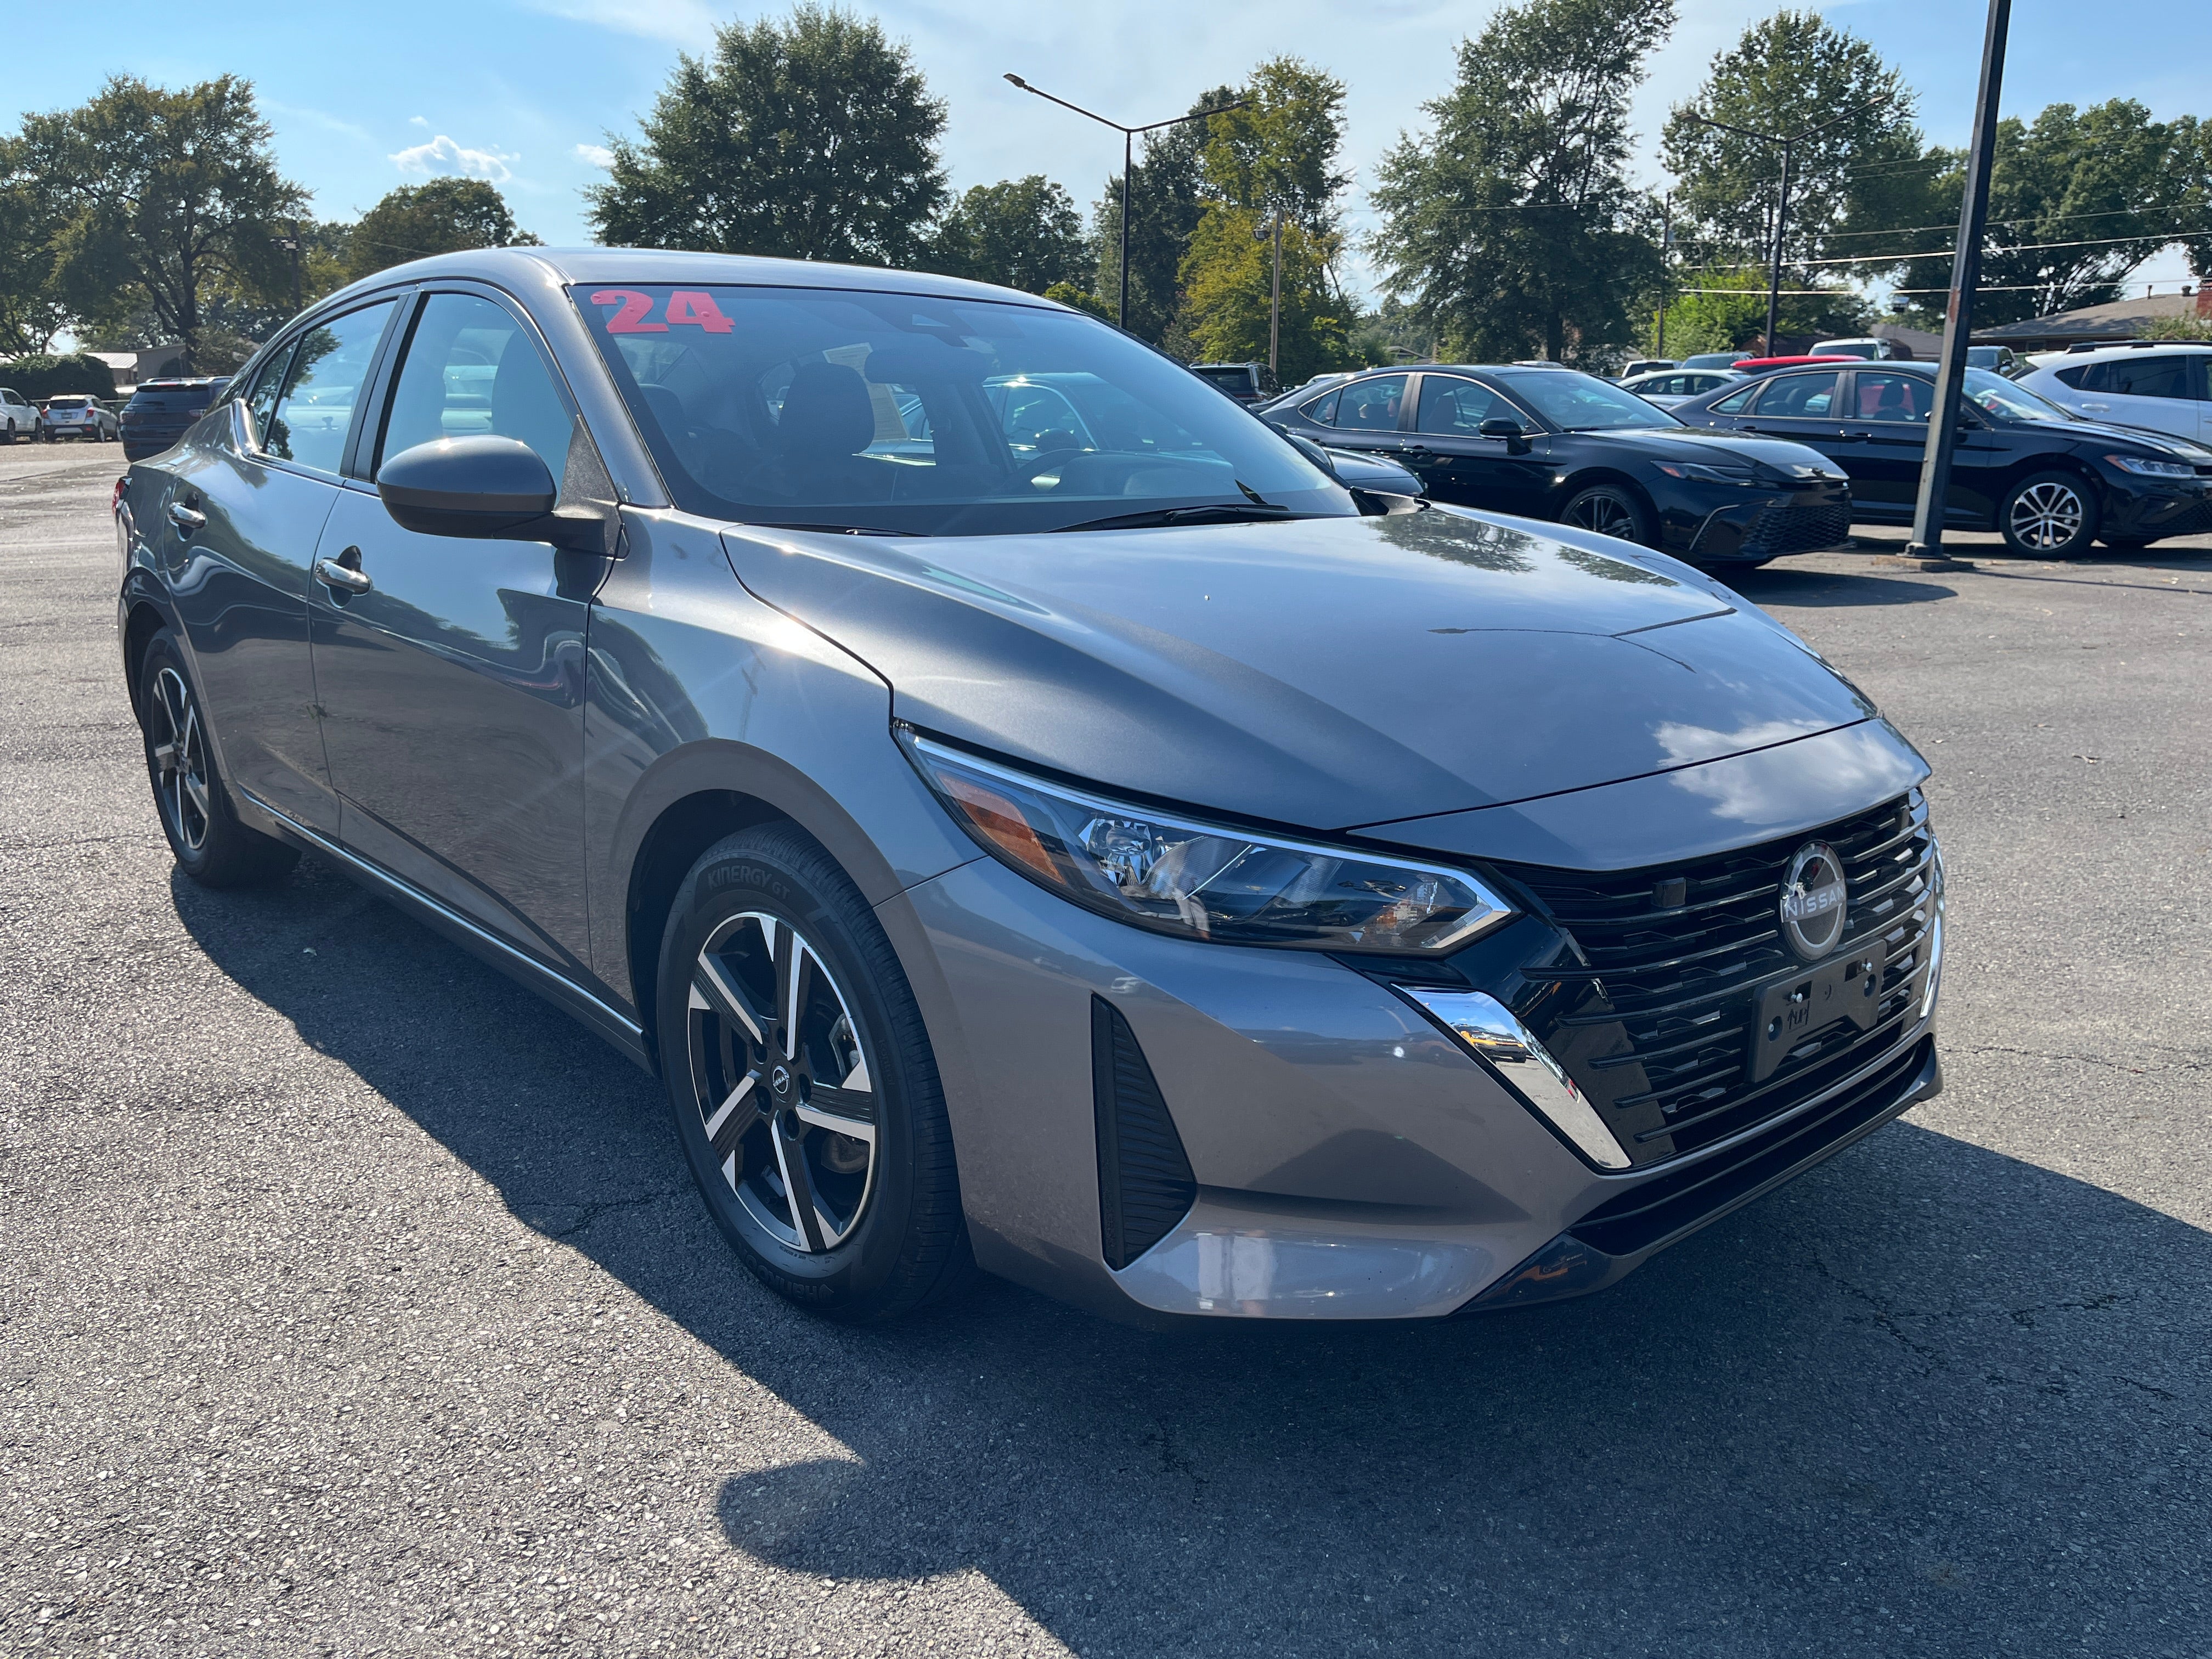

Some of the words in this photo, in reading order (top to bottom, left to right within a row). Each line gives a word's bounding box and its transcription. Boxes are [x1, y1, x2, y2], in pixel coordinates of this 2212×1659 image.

[590, 289, 736, 334] 24
[772, 881, 791, 899] GT
[1785, 884, 1844, 918] NISSAN
